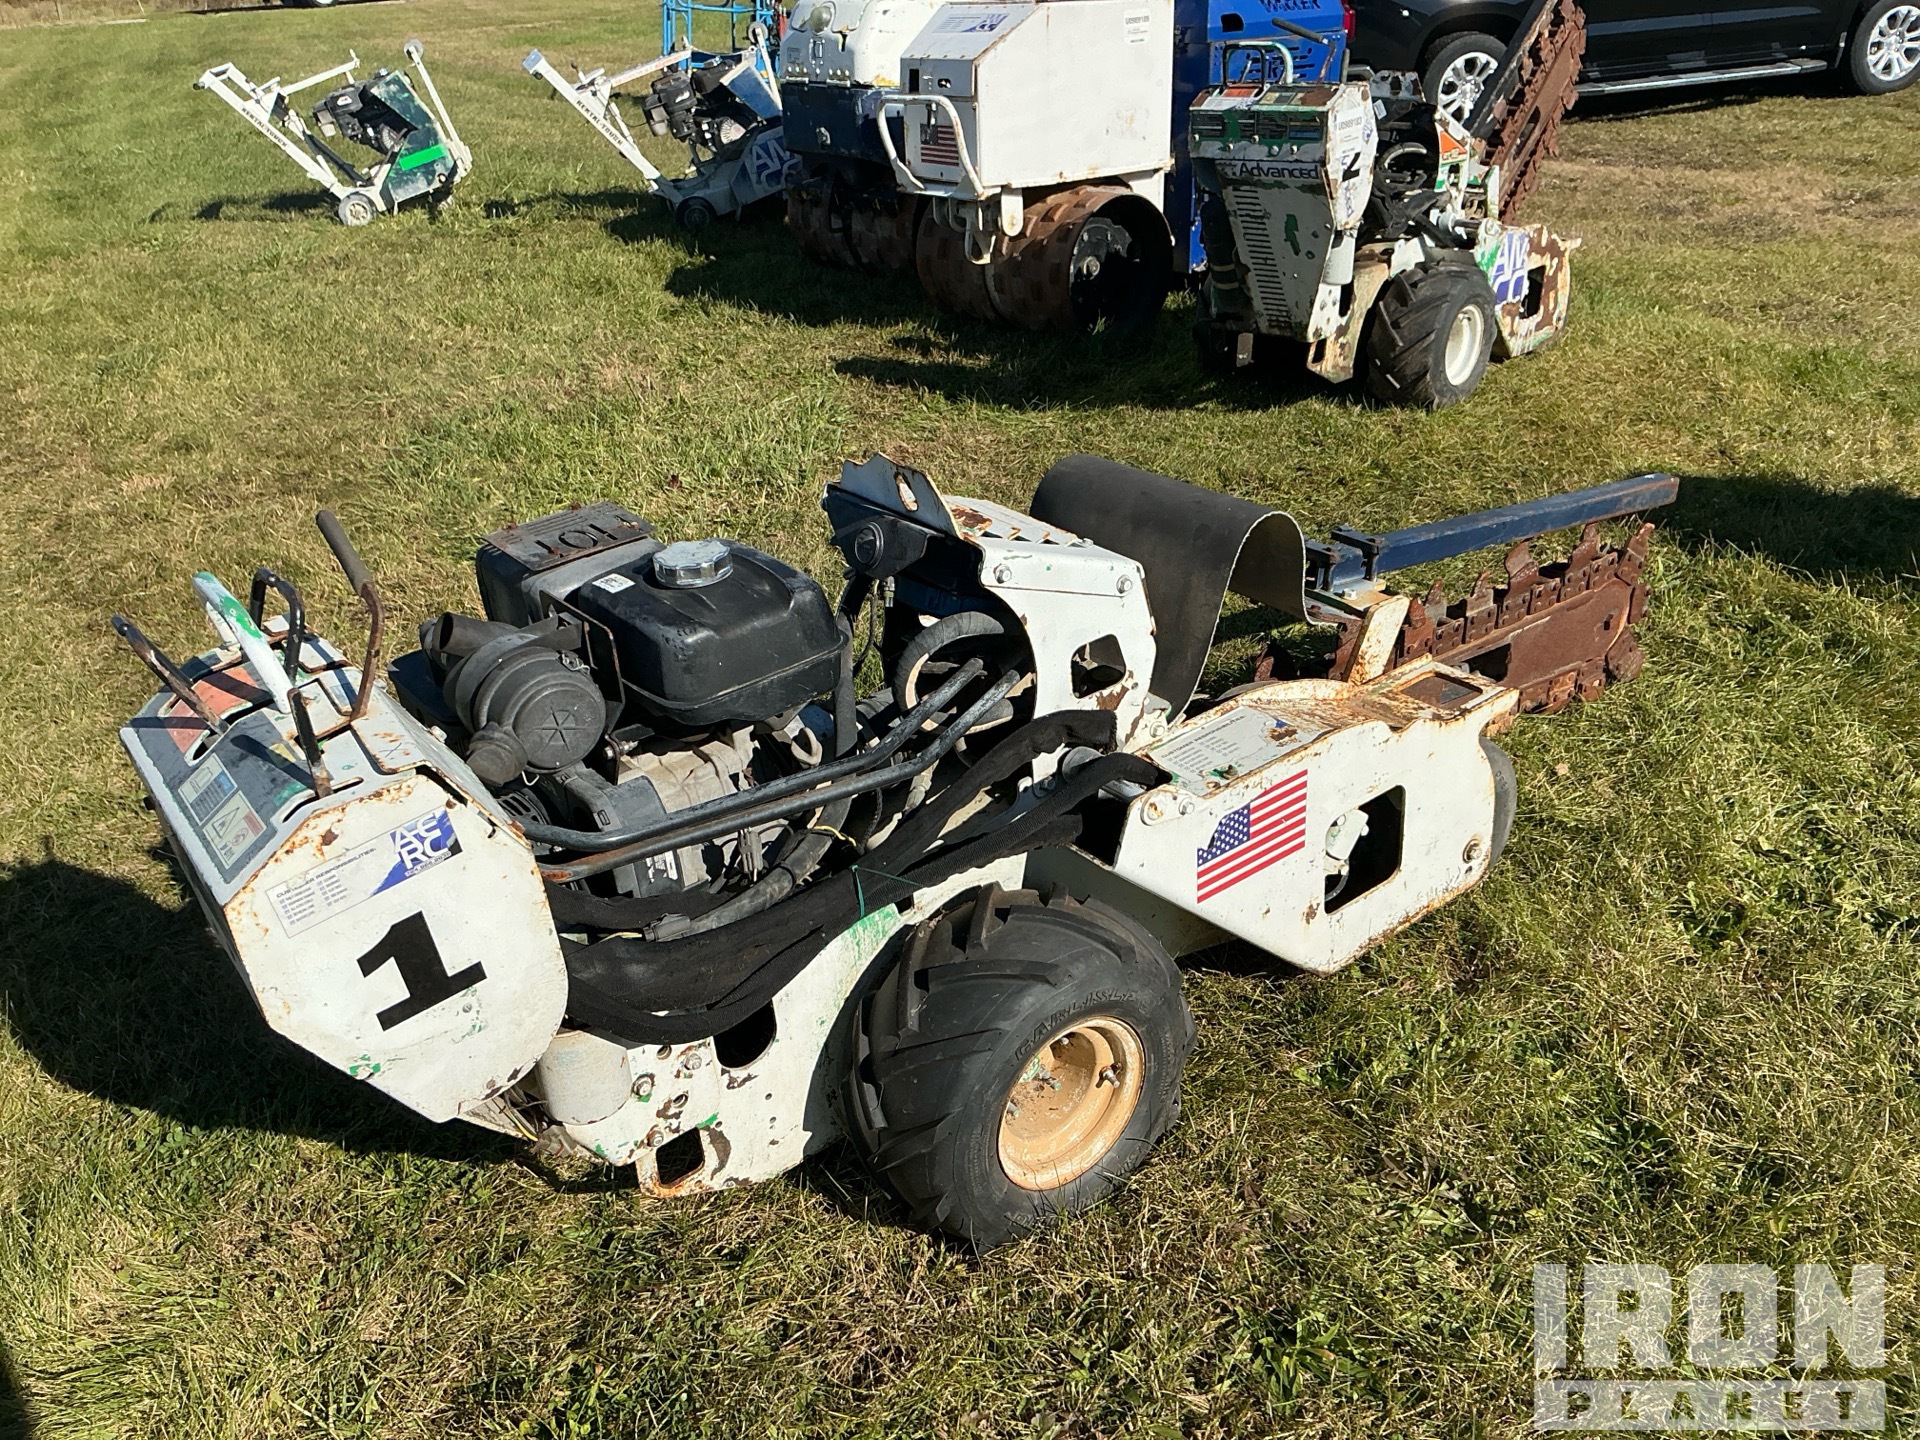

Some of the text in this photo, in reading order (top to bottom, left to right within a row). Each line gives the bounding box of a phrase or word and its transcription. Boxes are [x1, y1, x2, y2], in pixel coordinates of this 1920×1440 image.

[1238, 162, 1320, 179] Advanced
[356, 909, 487, 1032] 1
[1014, 989, 1138, 1061] CARLISLE
